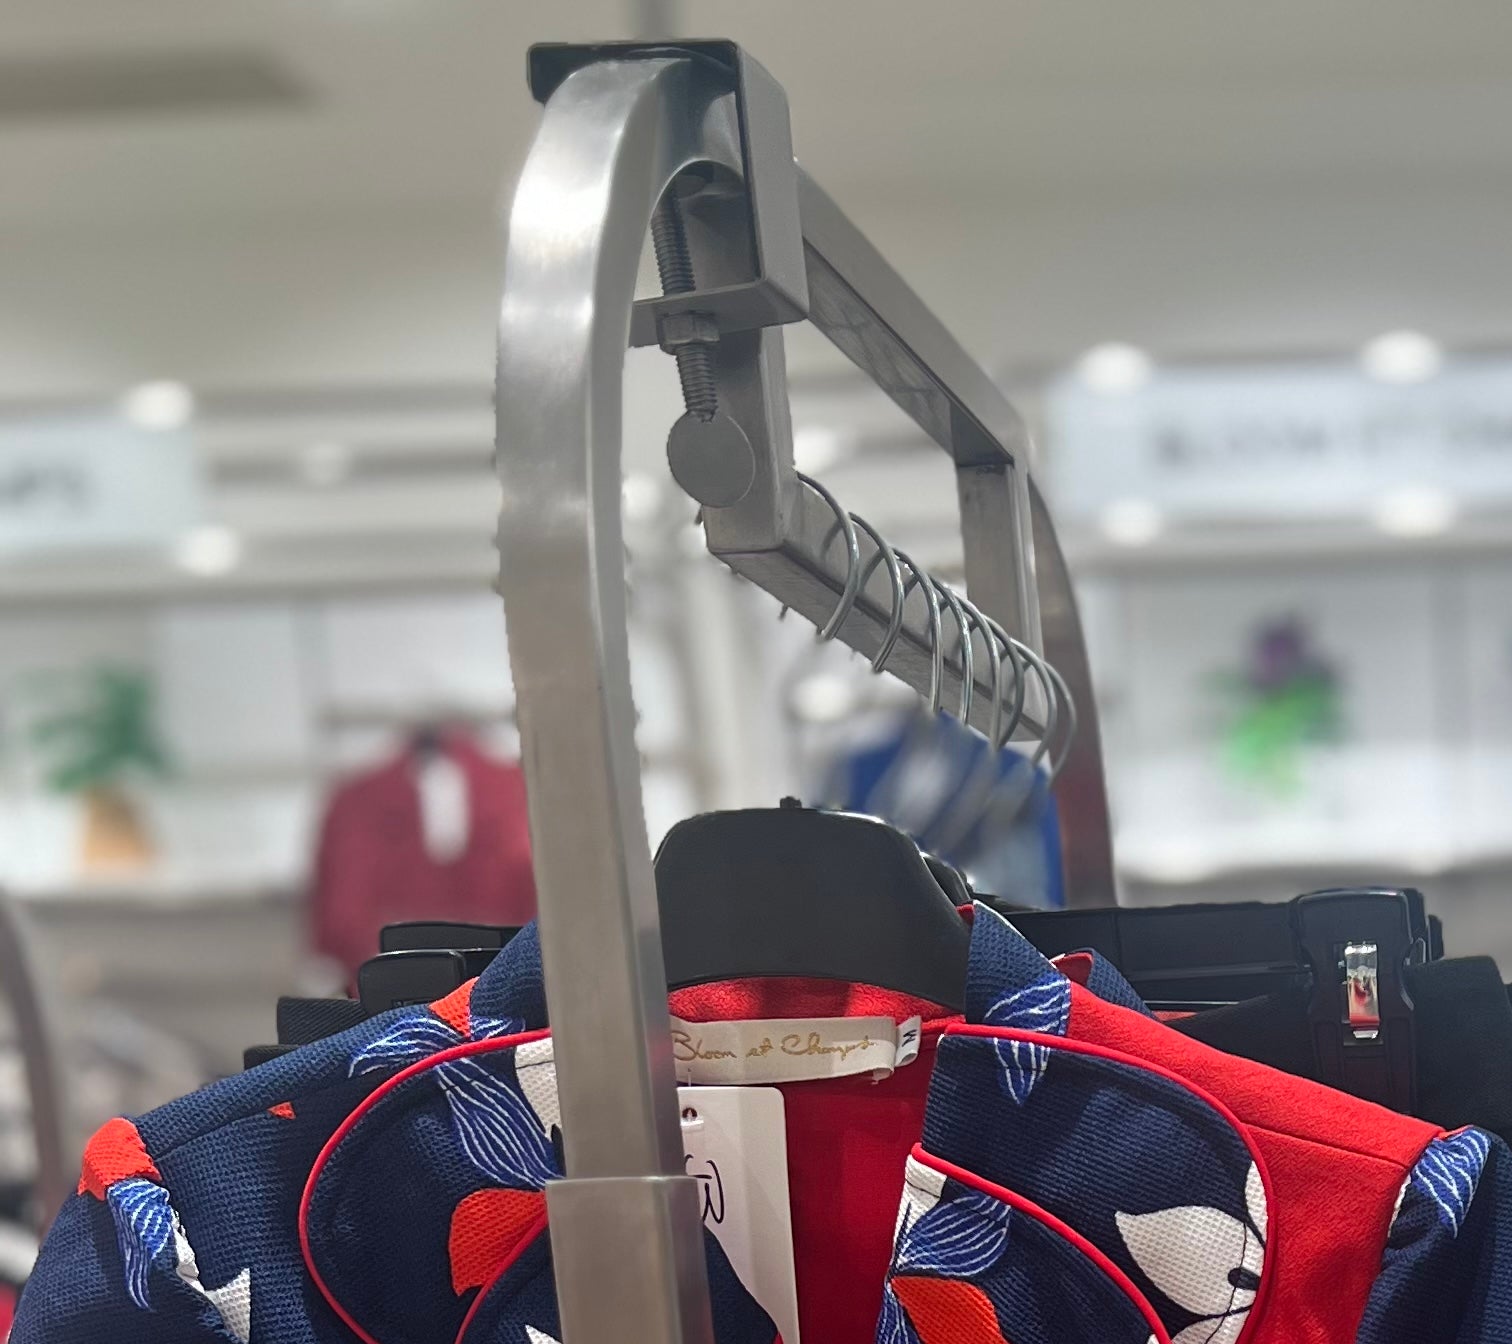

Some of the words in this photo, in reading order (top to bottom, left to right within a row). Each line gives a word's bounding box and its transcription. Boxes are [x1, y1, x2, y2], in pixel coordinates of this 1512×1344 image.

[671, 1030, 737, 1061] Bloom
[746, 1037, 774, 1058] et
[901, 1029, 918, 1048] M
